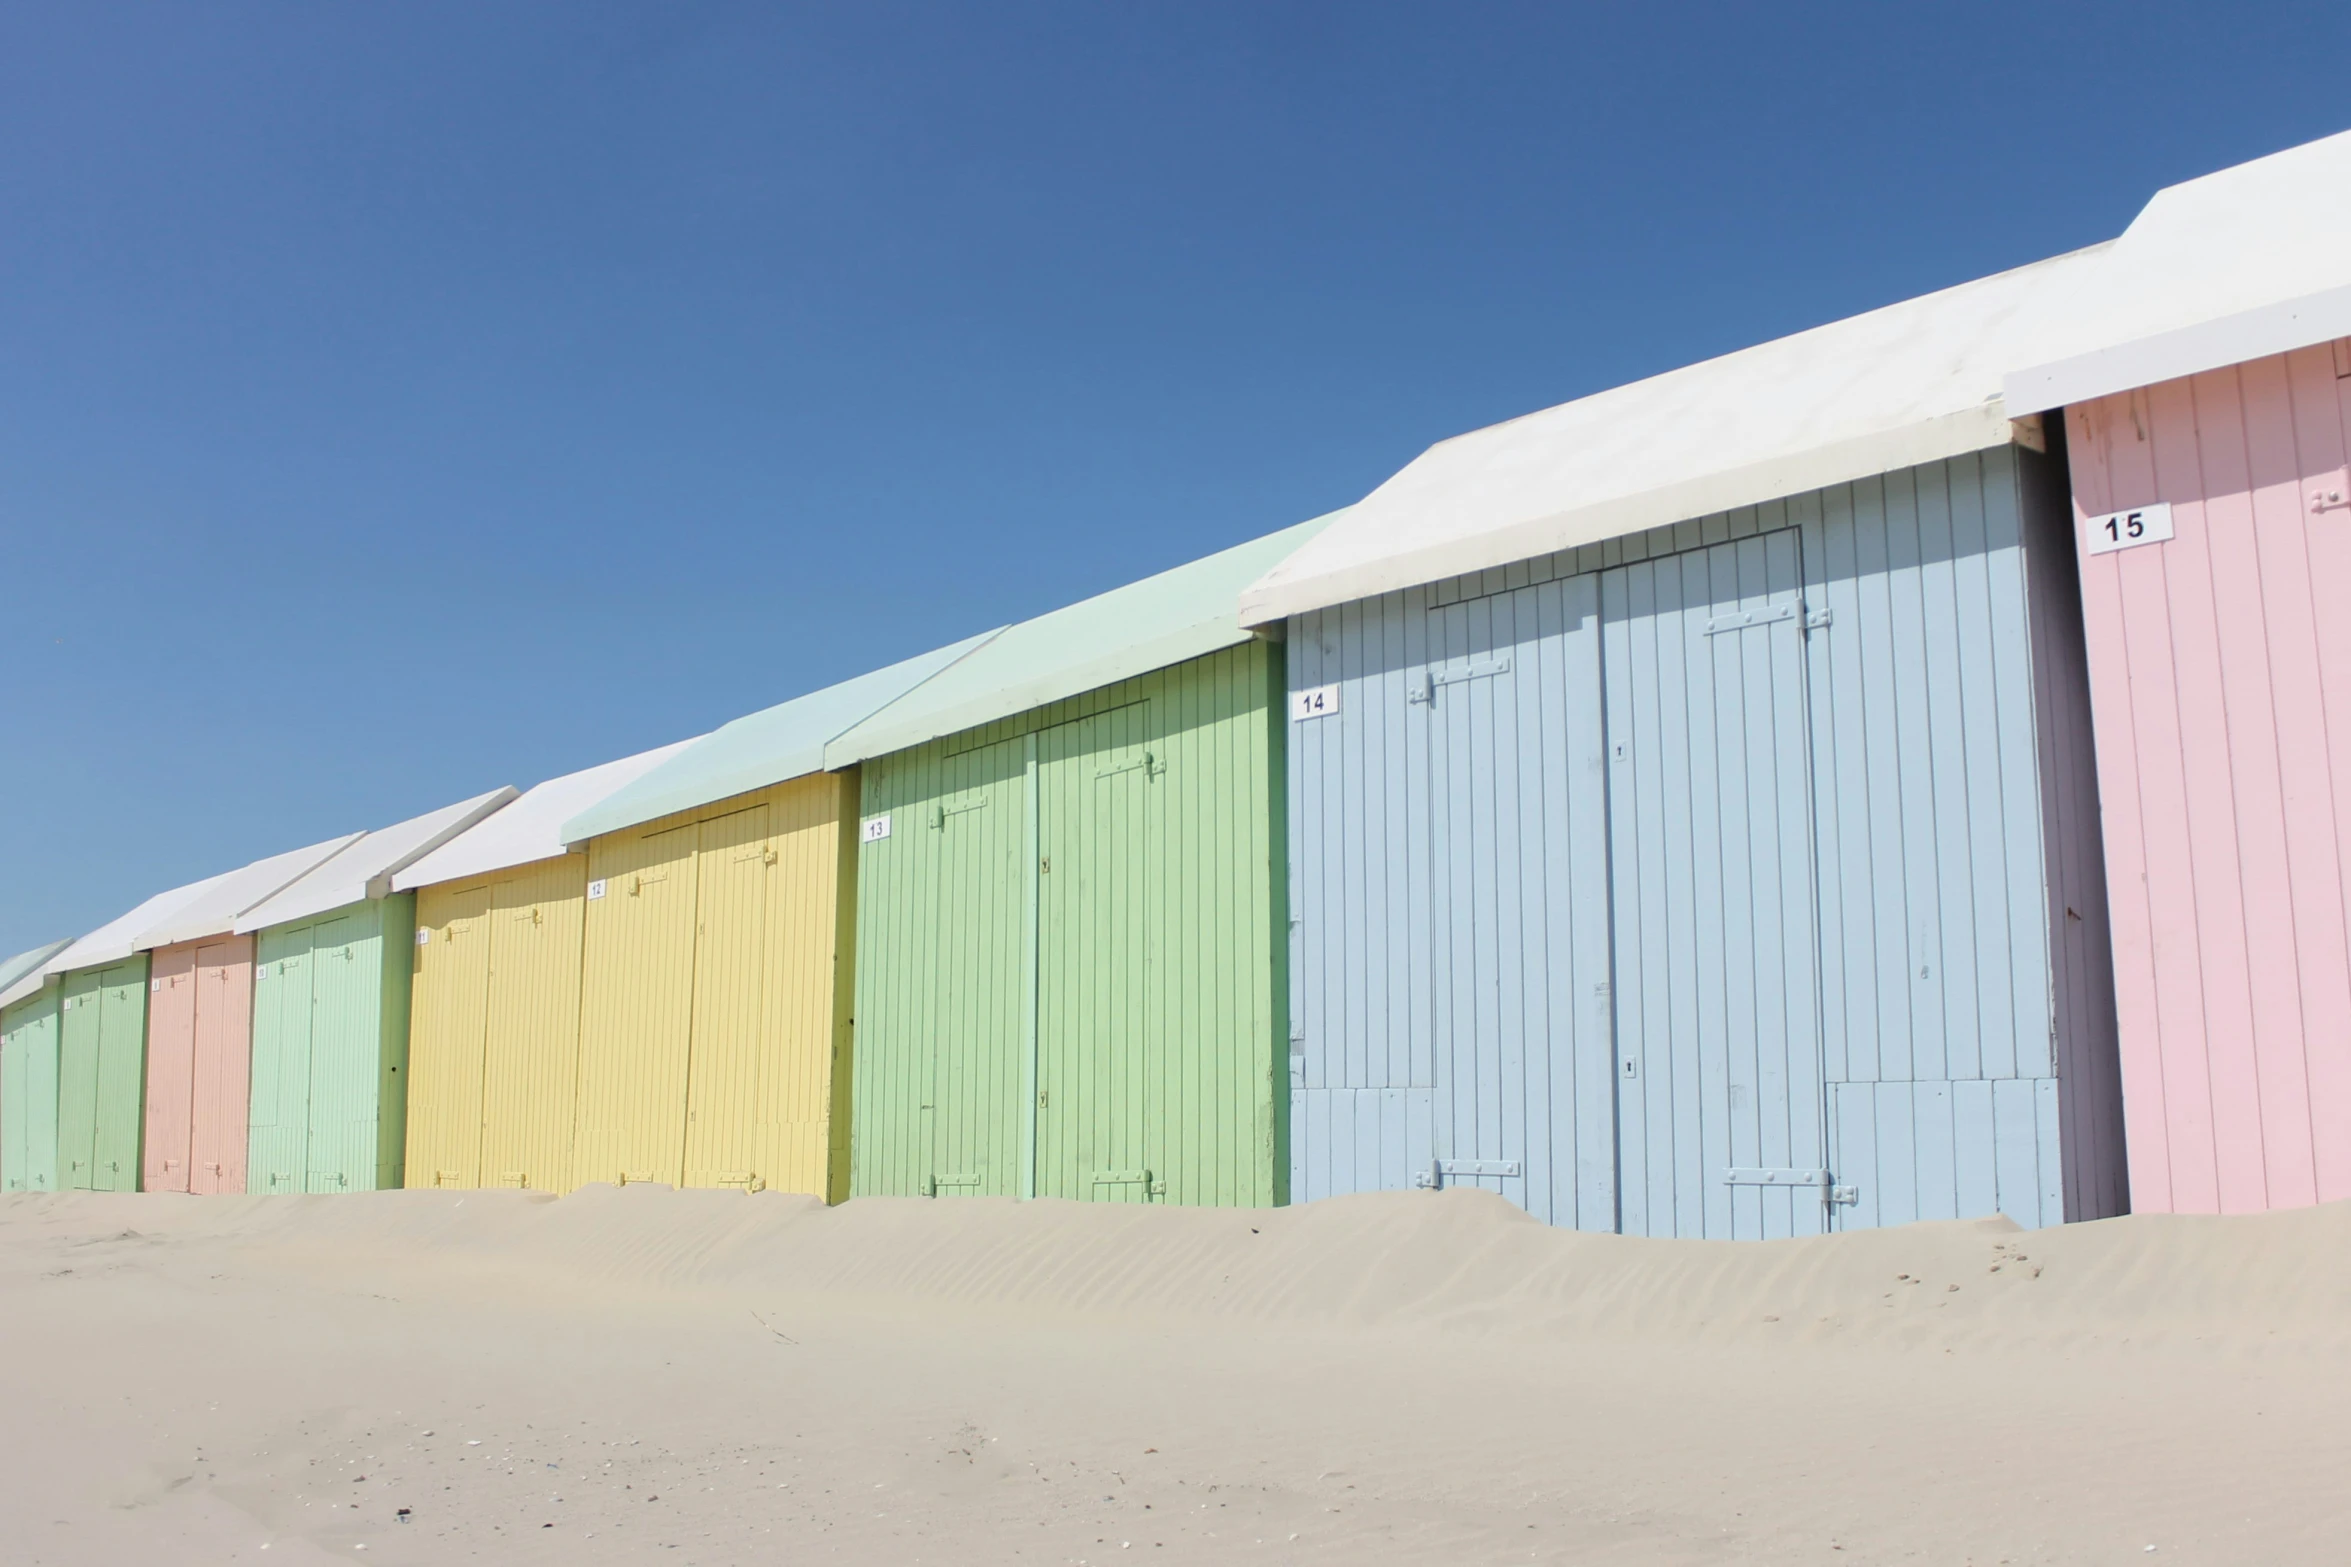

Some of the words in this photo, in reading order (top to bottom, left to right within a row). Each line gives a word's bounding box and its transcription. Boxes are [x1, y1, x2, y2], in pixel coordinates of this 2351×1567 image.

[2105, 513, 2144, 542] 15
[1303, 692, 1324, 713] 14
[870, 821, 882, 838] 13
[592, 883, 601, 895] 12
